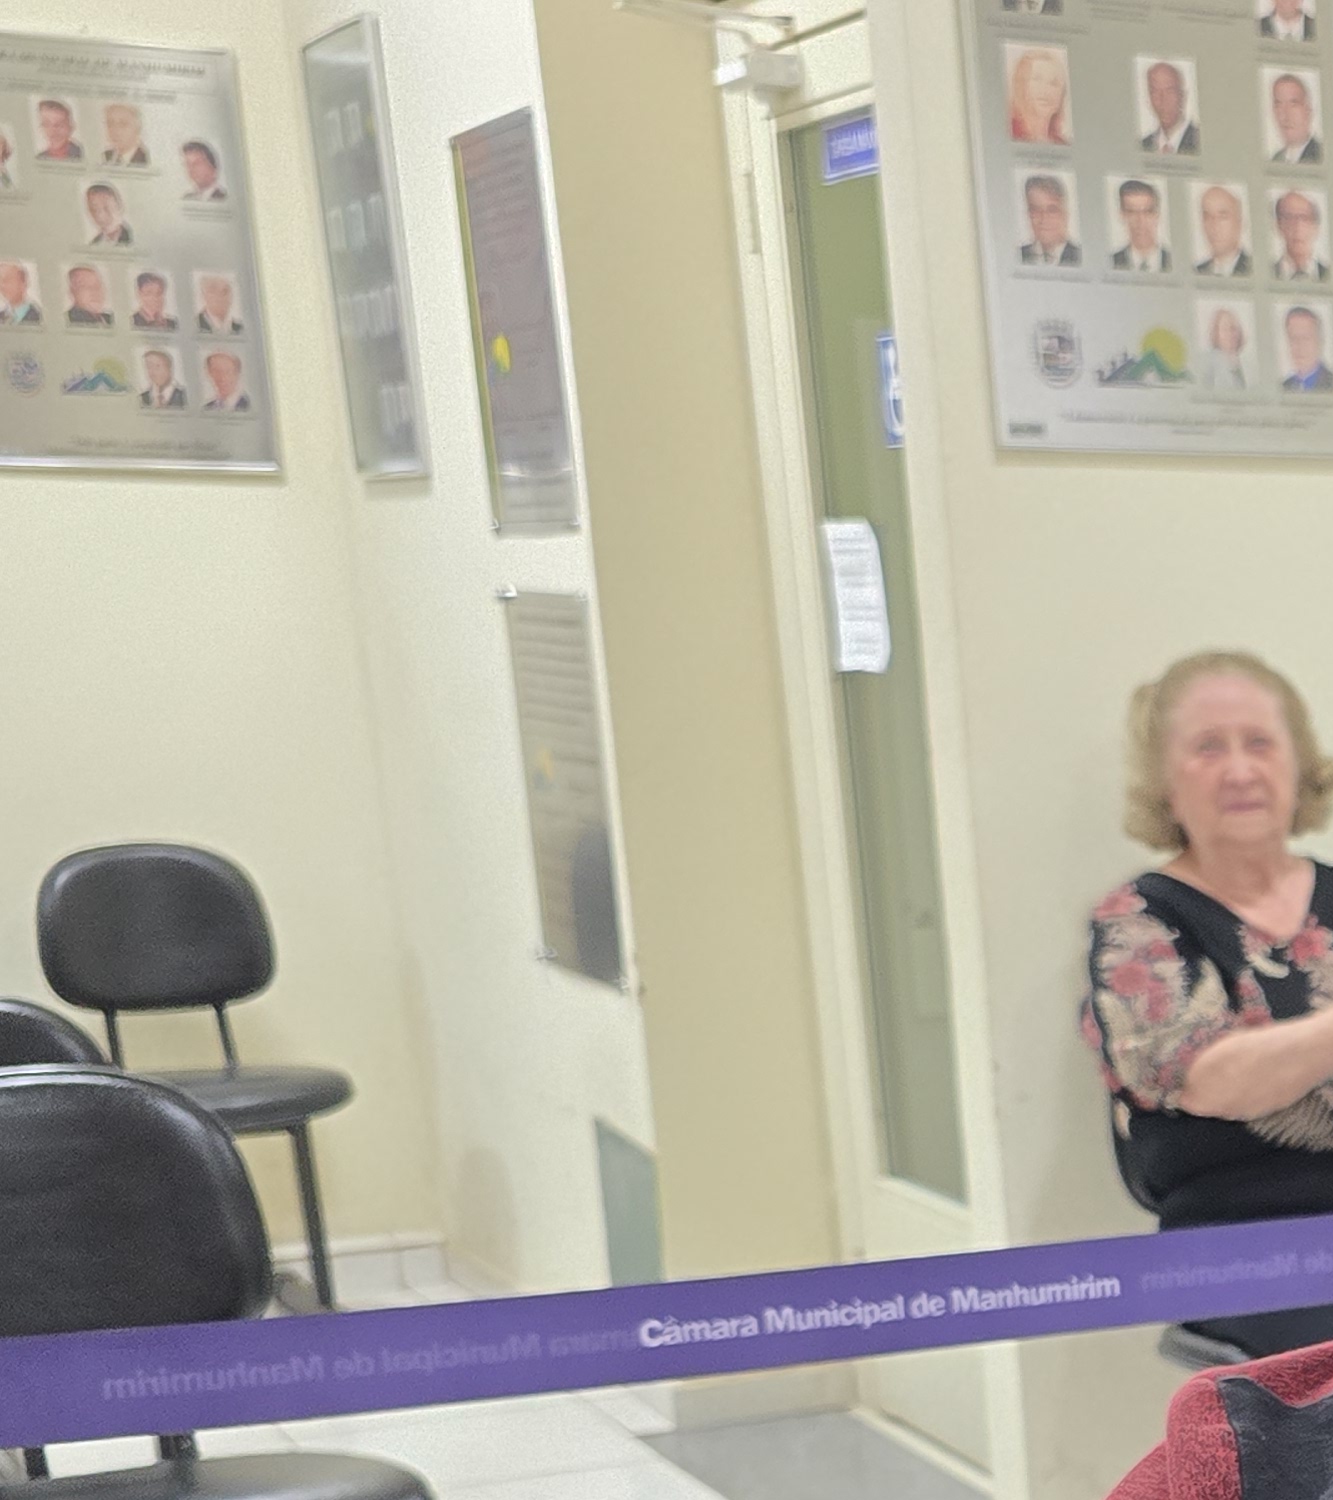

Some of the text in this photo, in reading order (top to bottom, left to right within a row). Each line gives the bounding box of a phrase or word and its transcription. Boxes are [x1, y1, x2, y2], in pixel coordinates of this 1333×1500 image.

[639, 1273, 1122, 1348] Câmara Municipal de Manhumirim
